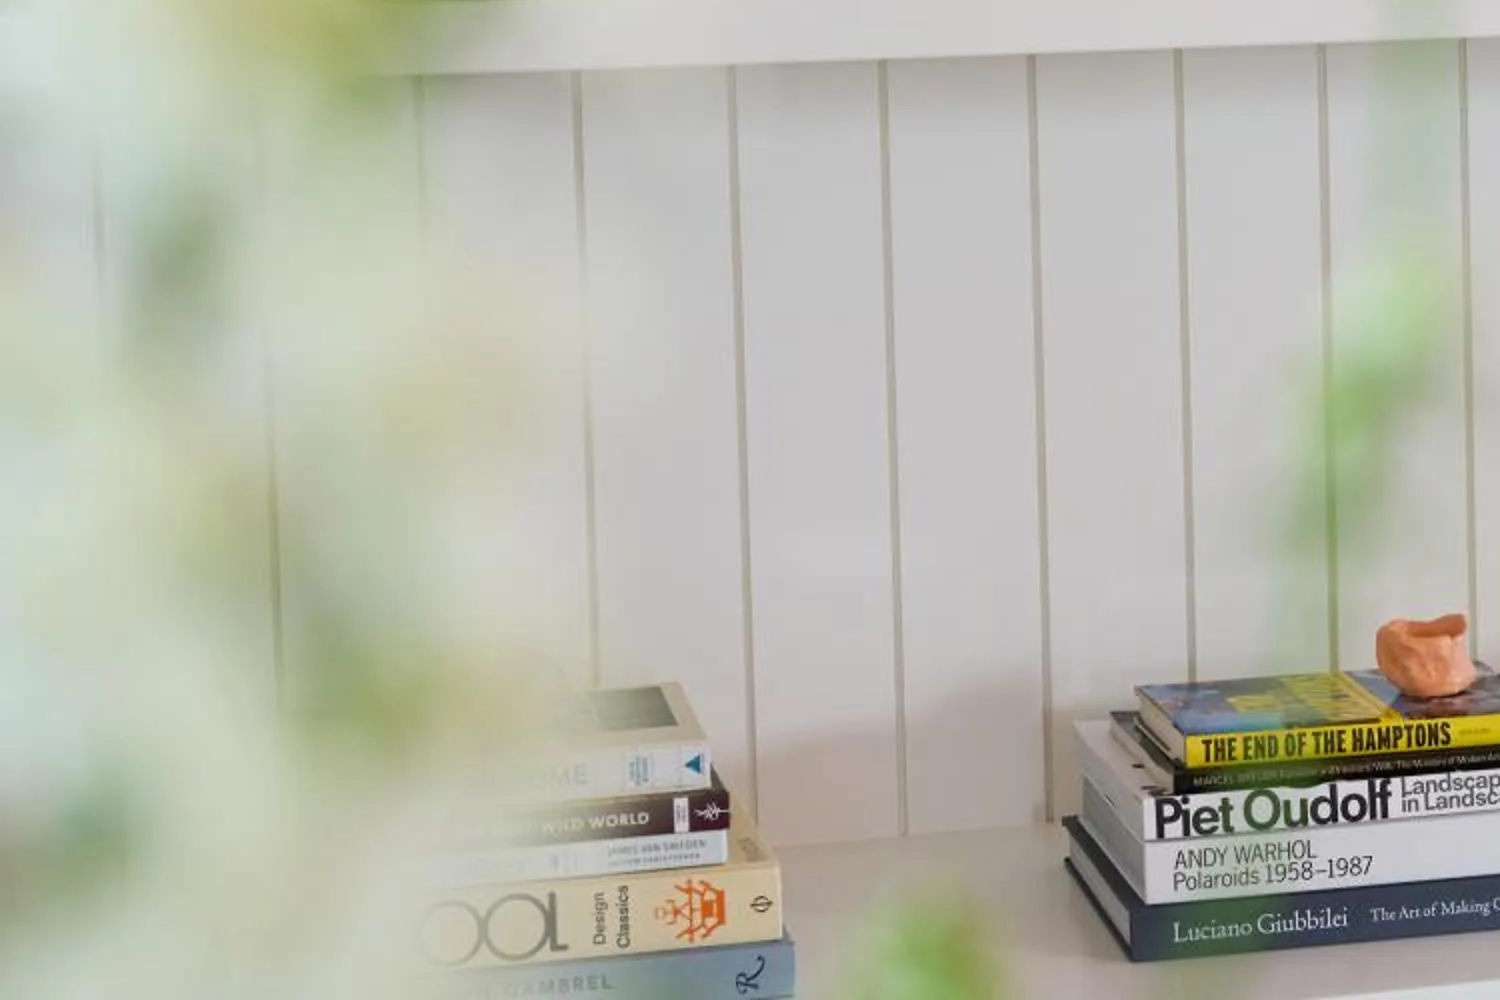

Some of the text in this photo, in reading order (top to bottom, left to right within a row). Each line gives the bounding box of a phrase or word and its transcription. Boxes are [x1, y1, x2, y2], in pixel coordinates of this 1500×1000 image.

[1202, 722, 1452, 763] THE END OF THE HAMPTONS
[540, 810, 650, 834] WILD WORLD
[1154, 776, 1394, 840] Piet Oudolf
[1400, 795, 1421, 813] in
[1173, 838, 1319, 870] ANDY WARHOL
[1173, 864, 1260, 893] Polaroids
[591, 891, 608, 946] Design
[616, 884, 631, 949] Classics
[1172, 918, 1253, 945] Luciano
[1256, 910, 1349, 936] Giubbilei
[1369, 906, 1397, 924] The
[1398, 904, 1421, 921] Art
[1422, 901, 1438, 919] of
[1440, 899, 1491, 920] Making
